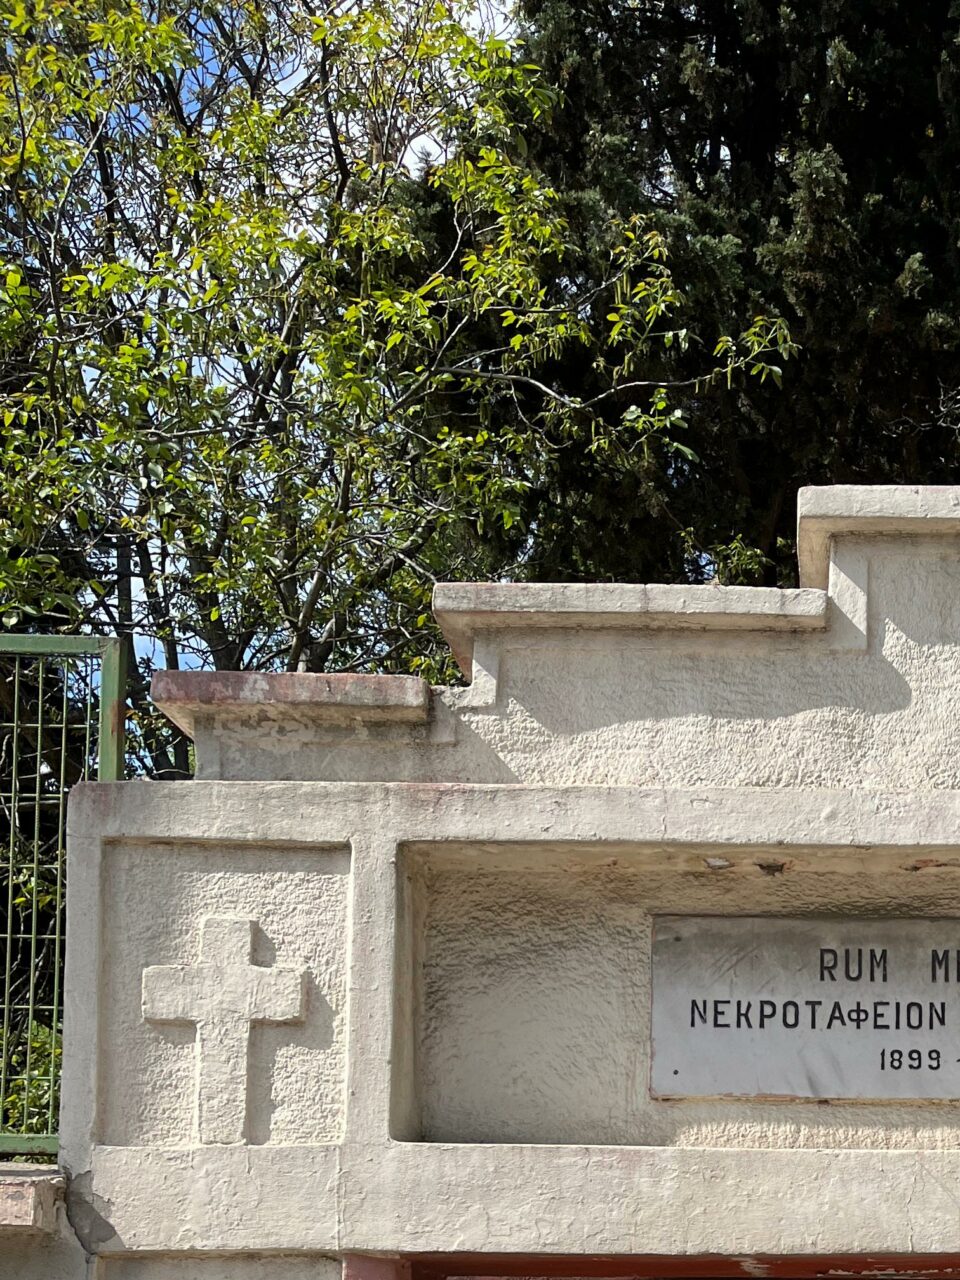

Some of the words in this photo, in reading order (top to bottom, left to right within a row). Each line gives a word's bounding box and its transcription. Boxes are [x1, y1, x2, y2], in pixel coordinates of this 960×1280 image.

[819, 948, 888, 983] RUM
[690, 998, 946, 1031] ΝΕΚΡΟΤΑΦΕΙΟΝ
[880, 1048, 941, 1071] 1899
